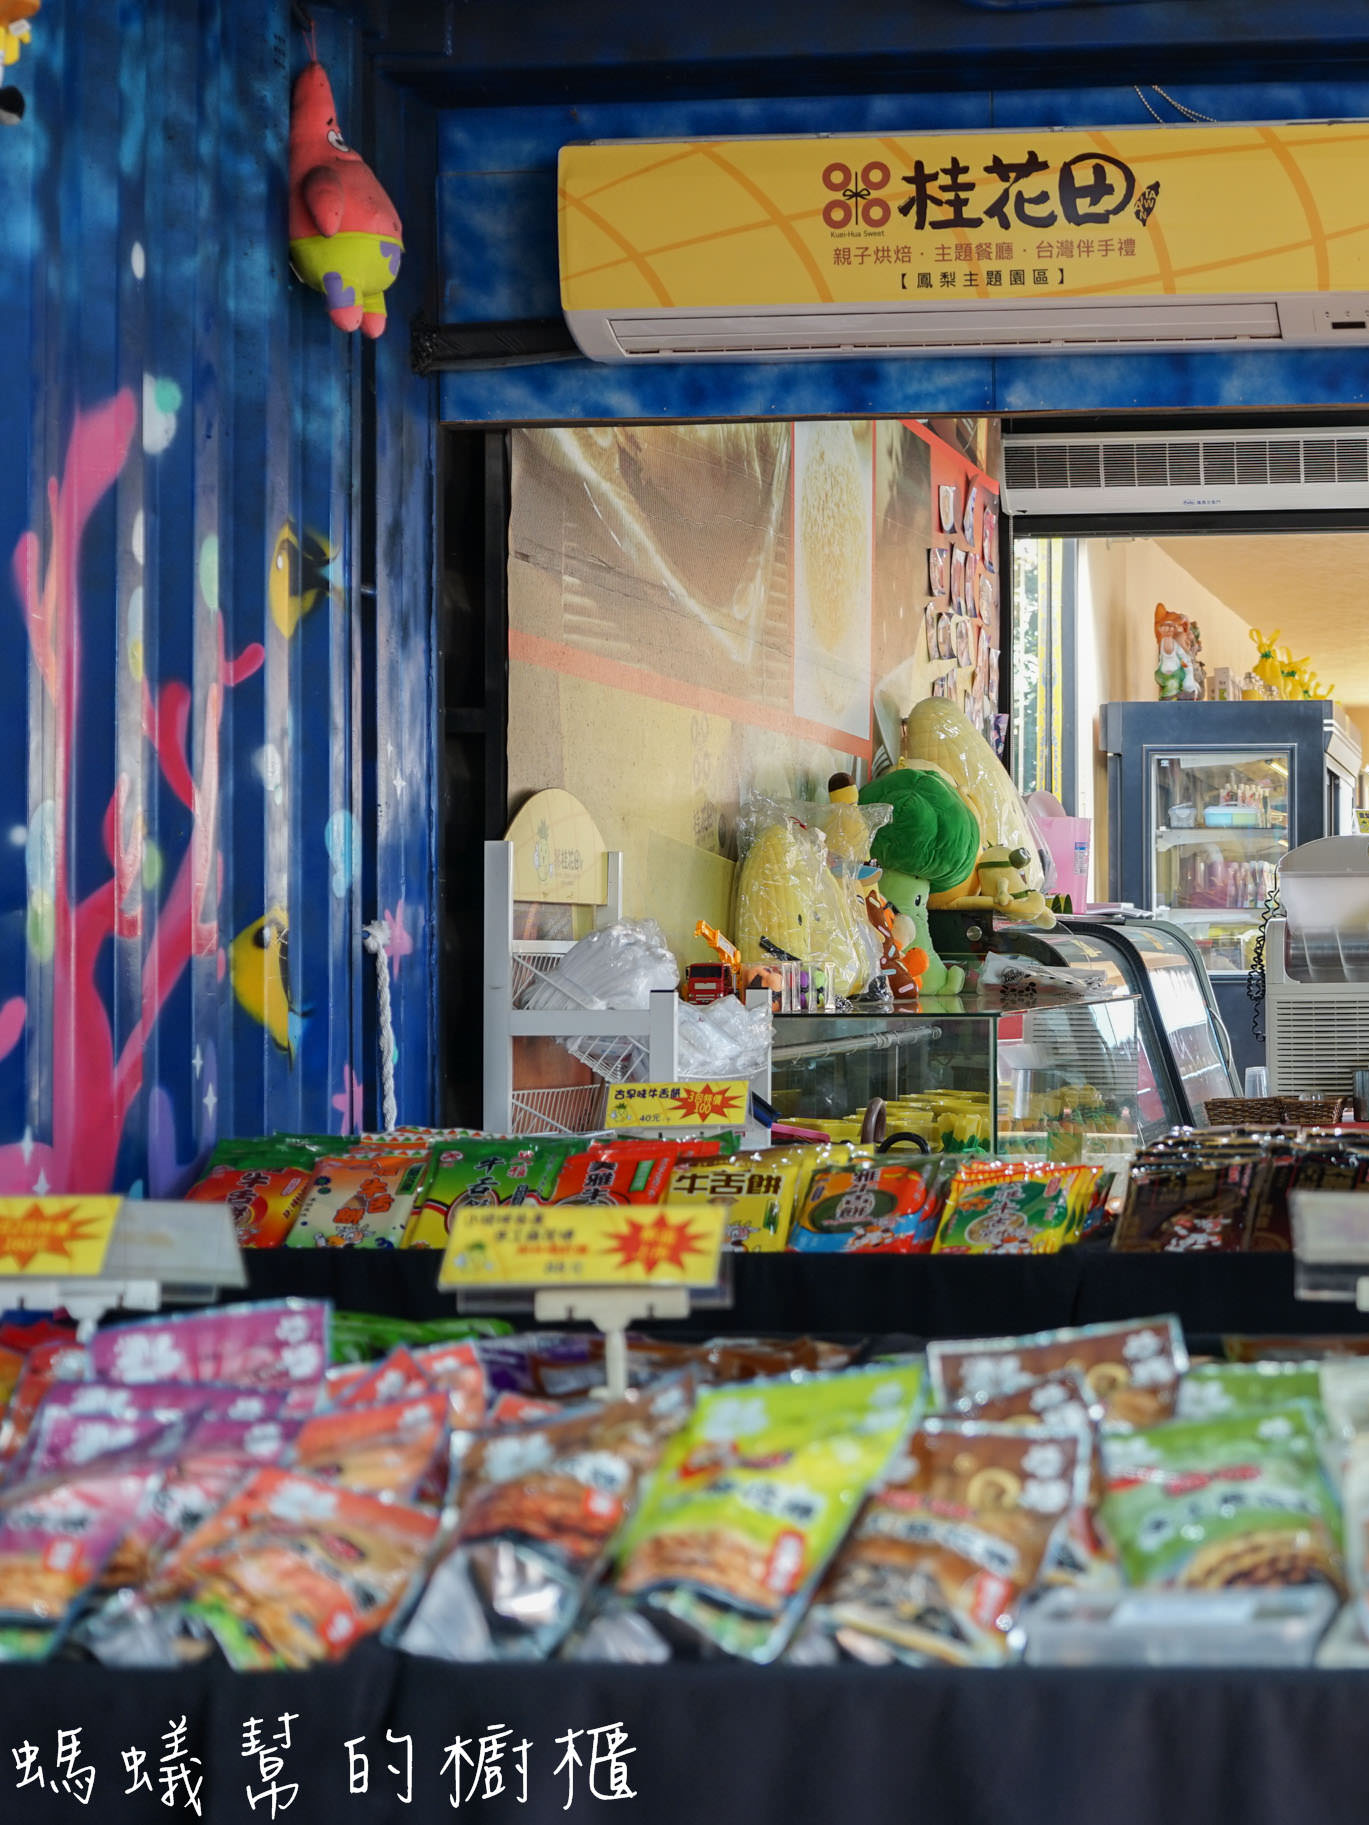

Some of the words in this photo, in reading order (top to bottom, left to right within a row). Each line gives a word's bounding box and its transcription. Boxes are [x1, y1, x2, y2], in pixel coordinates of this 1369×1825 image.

[898, 151, 1136, 231] 桂花田
[614, 1087, 681, 1100] 古早味牛舌餅
[672, 1172, 783, 1196] 牛舌餅
